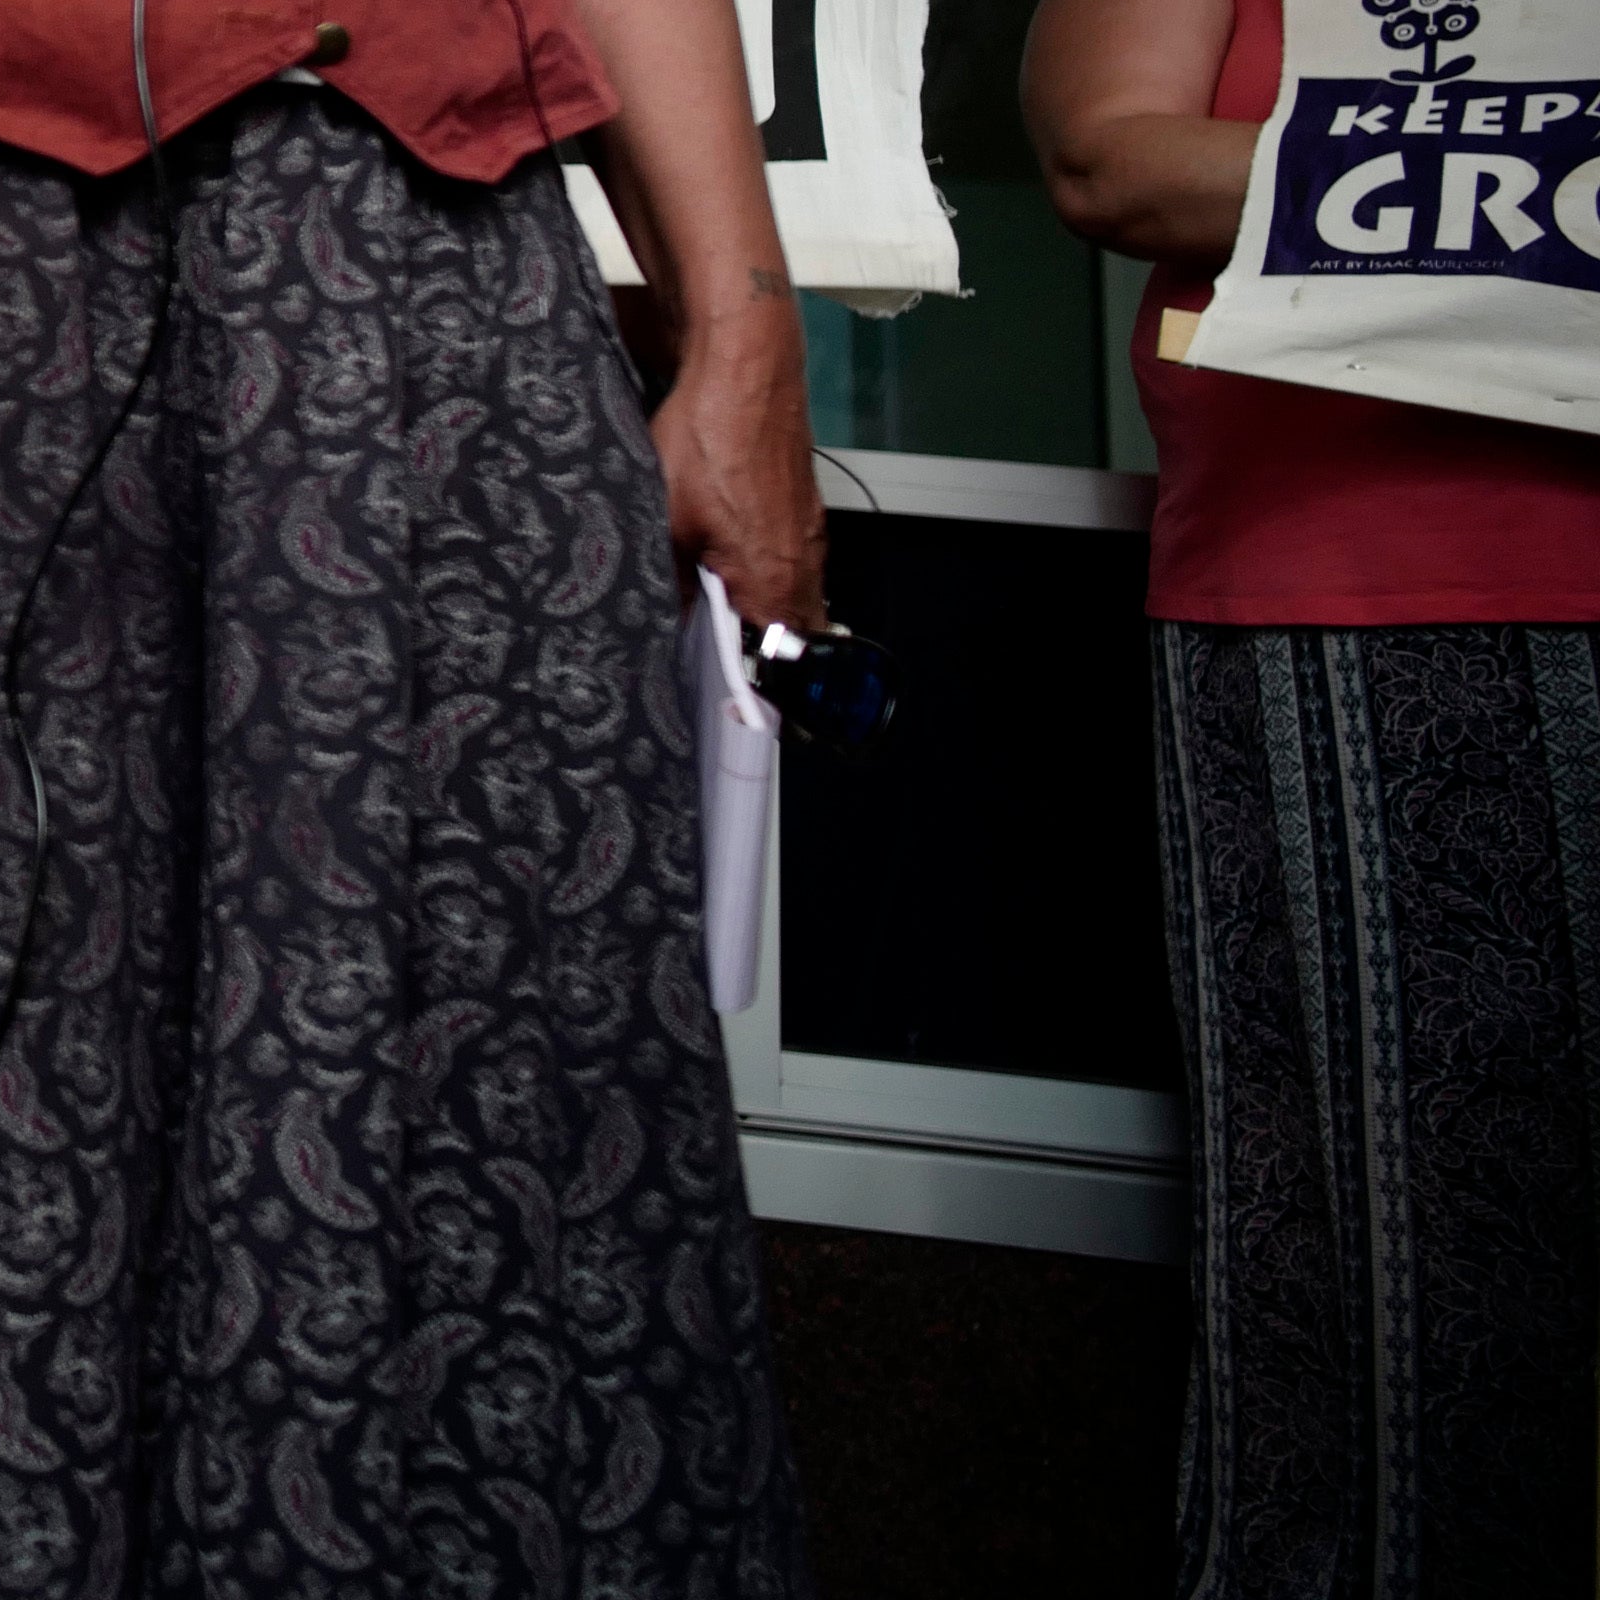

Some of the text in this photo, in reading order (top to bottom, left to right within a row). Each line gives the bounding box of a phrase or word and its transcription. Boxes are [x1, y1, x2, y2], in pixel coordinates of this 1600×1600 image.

[1326, 91, 1582, 138] KEEP
[1310, 259, 1340, 270] ART
[1346, 260, 1364, 270] BY
[1369, 259, 1414, 271] ISAAC
